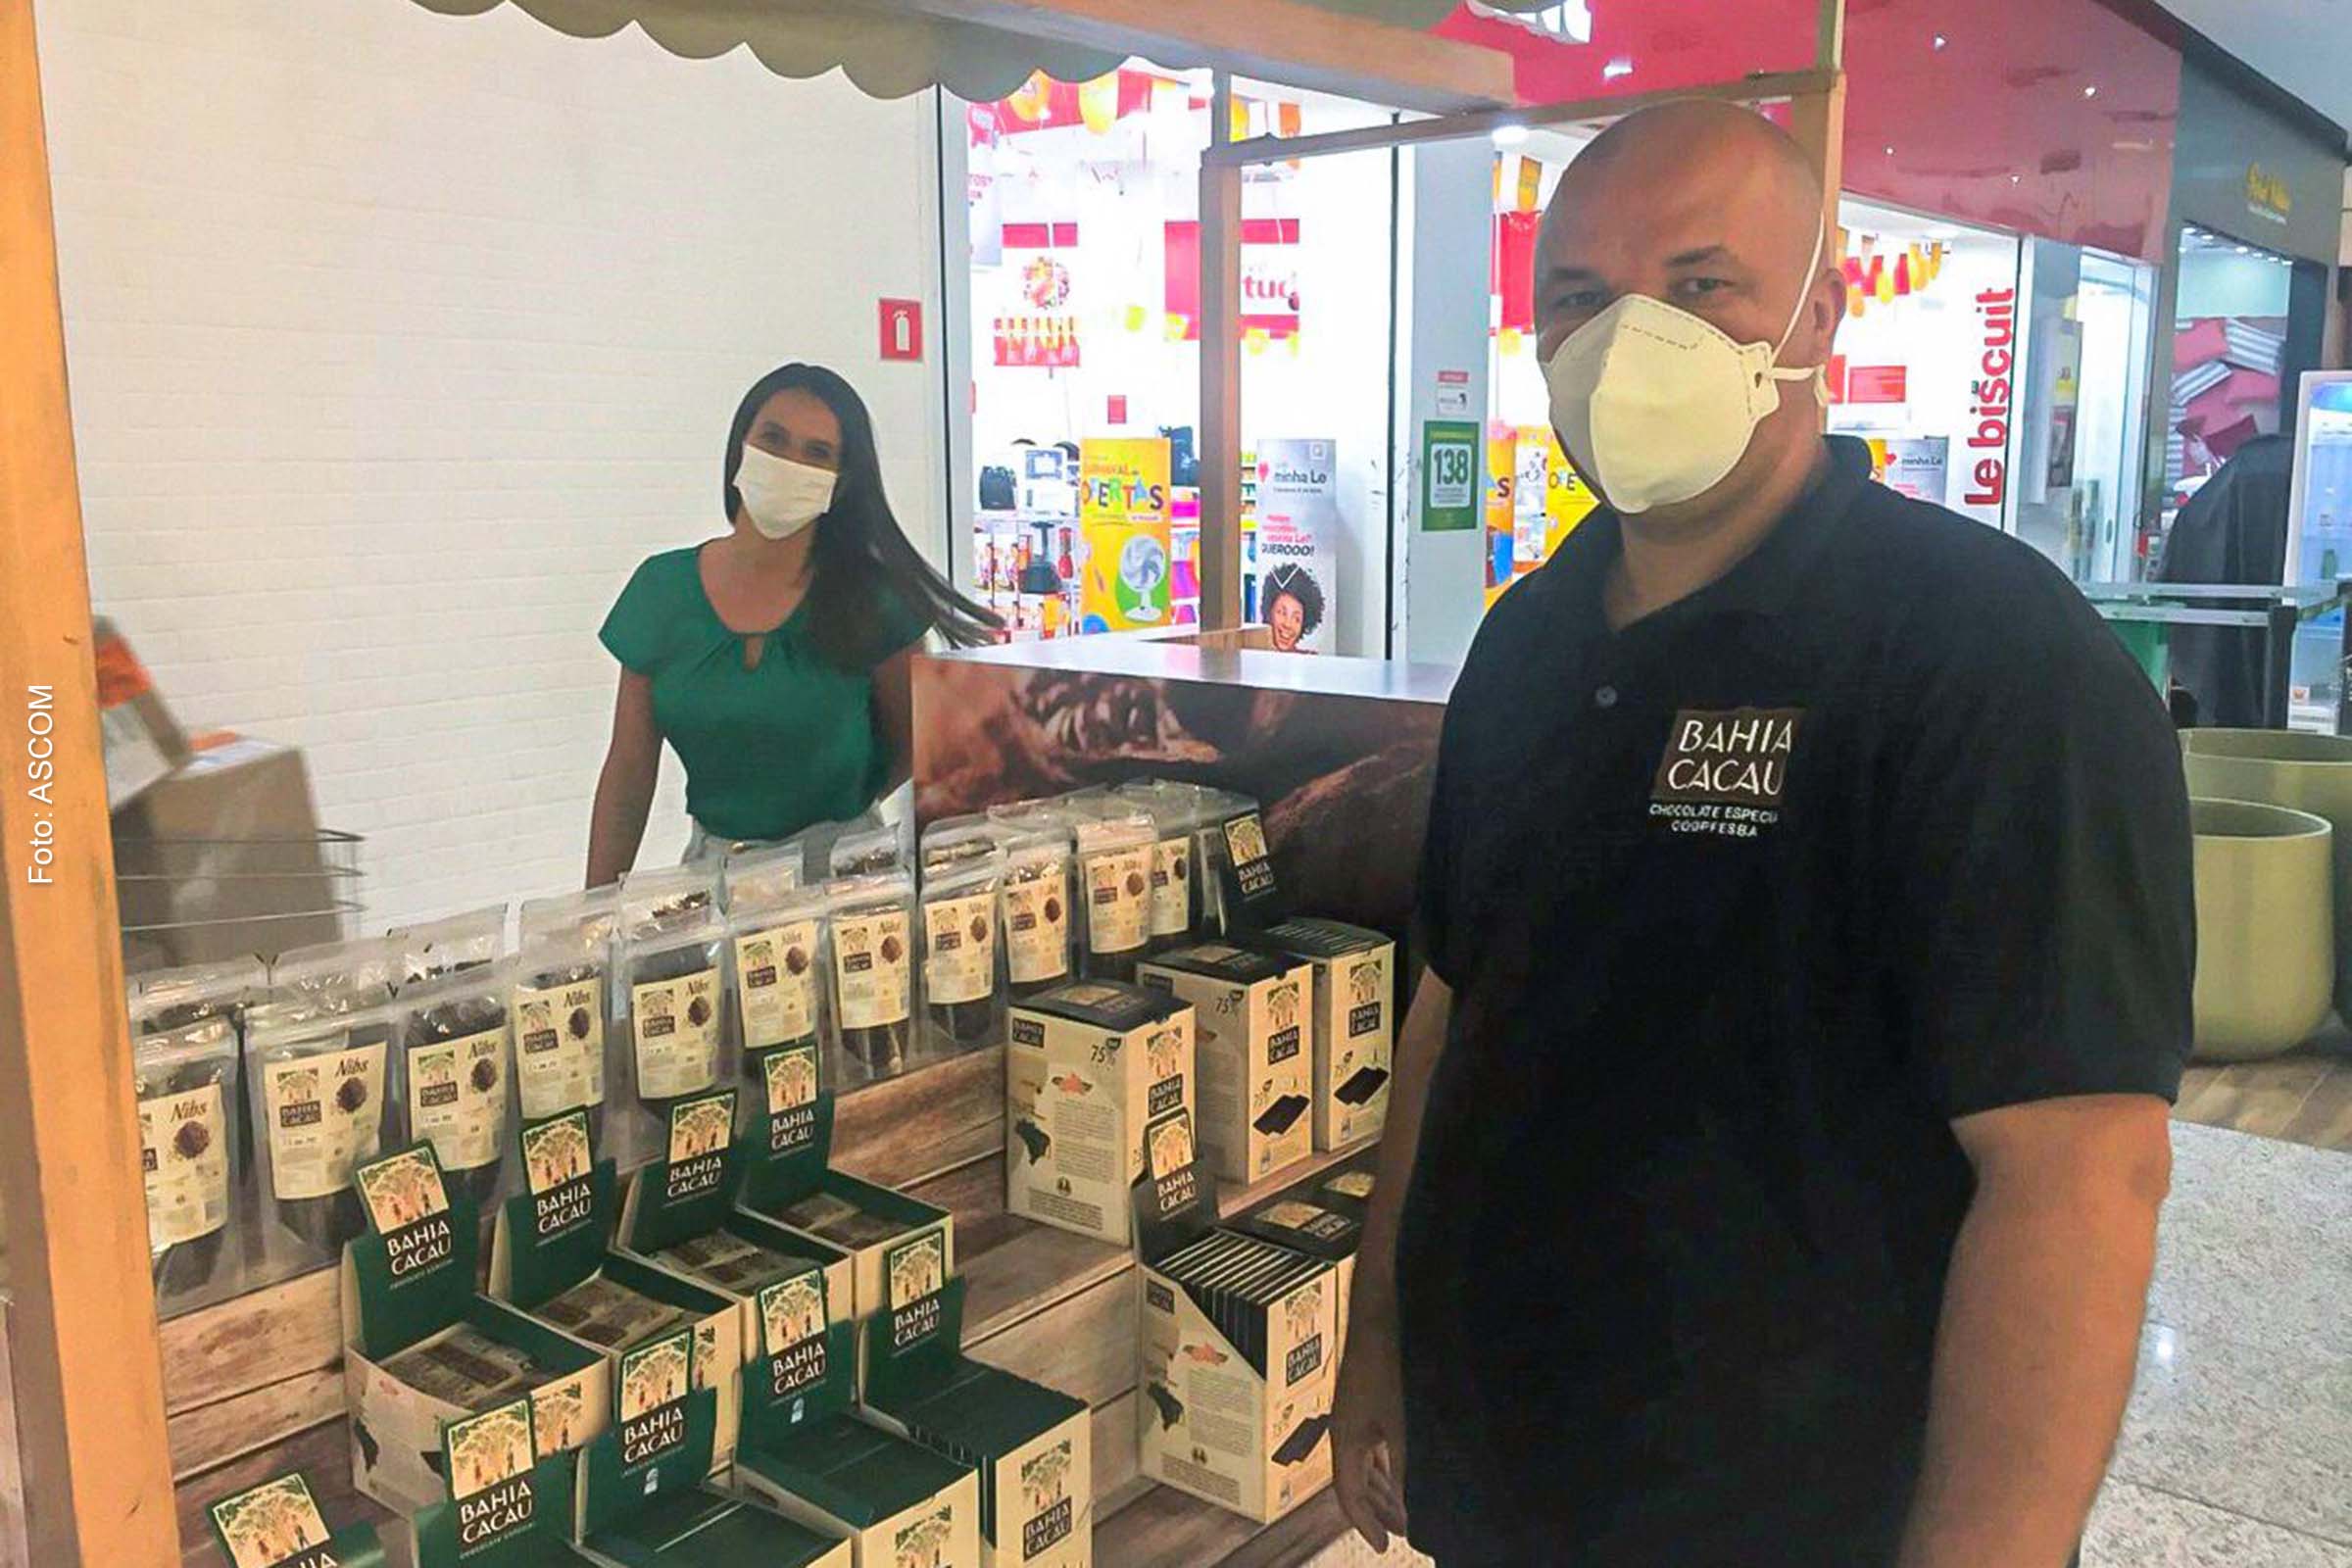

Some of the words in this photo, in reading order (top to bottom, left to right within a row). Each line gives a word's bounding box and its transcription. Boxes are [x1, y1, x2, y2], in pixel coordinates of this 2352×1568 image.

[1967, 287, 2014, 448] biscuit
[1434, 448, 1469, 485] 138
[1964, 458, 2003, 505] Le
[1678, 718, 1792, 753] BAHIA
[1667, 759, 1784, 796] CACAU
[334, 1056, 369, 1079] Nibs
[170, 1100, 208, 1123] Nibs
[771, 1125, 813, 1150] CACAU
[667, 1170, 722, 1198] CACAU
[669, 1156, 722, 1183] BAHIA
[537, 1183, 591, 1217] BAHIA
[538, 1198, 592, 1234] CACAU
[387, 1219, 451, 1256] BAHIA
[391, 1235, 451, 1276] CACAU
[894, 1312, 941, 1348] CACAU
[895, 1298, 941, 1332] BAHIA
[772, 1342, 825, 1378] BAHIA
[774, 1354, 826, 1395] CACAU
[624, 1406, 684, 1446] BAHIA
[624, 1422, 684, 1463] CACAU
[460, 1481, 532, 1525] BAHIA
[462, 1497, 533, 1544] CACAU
